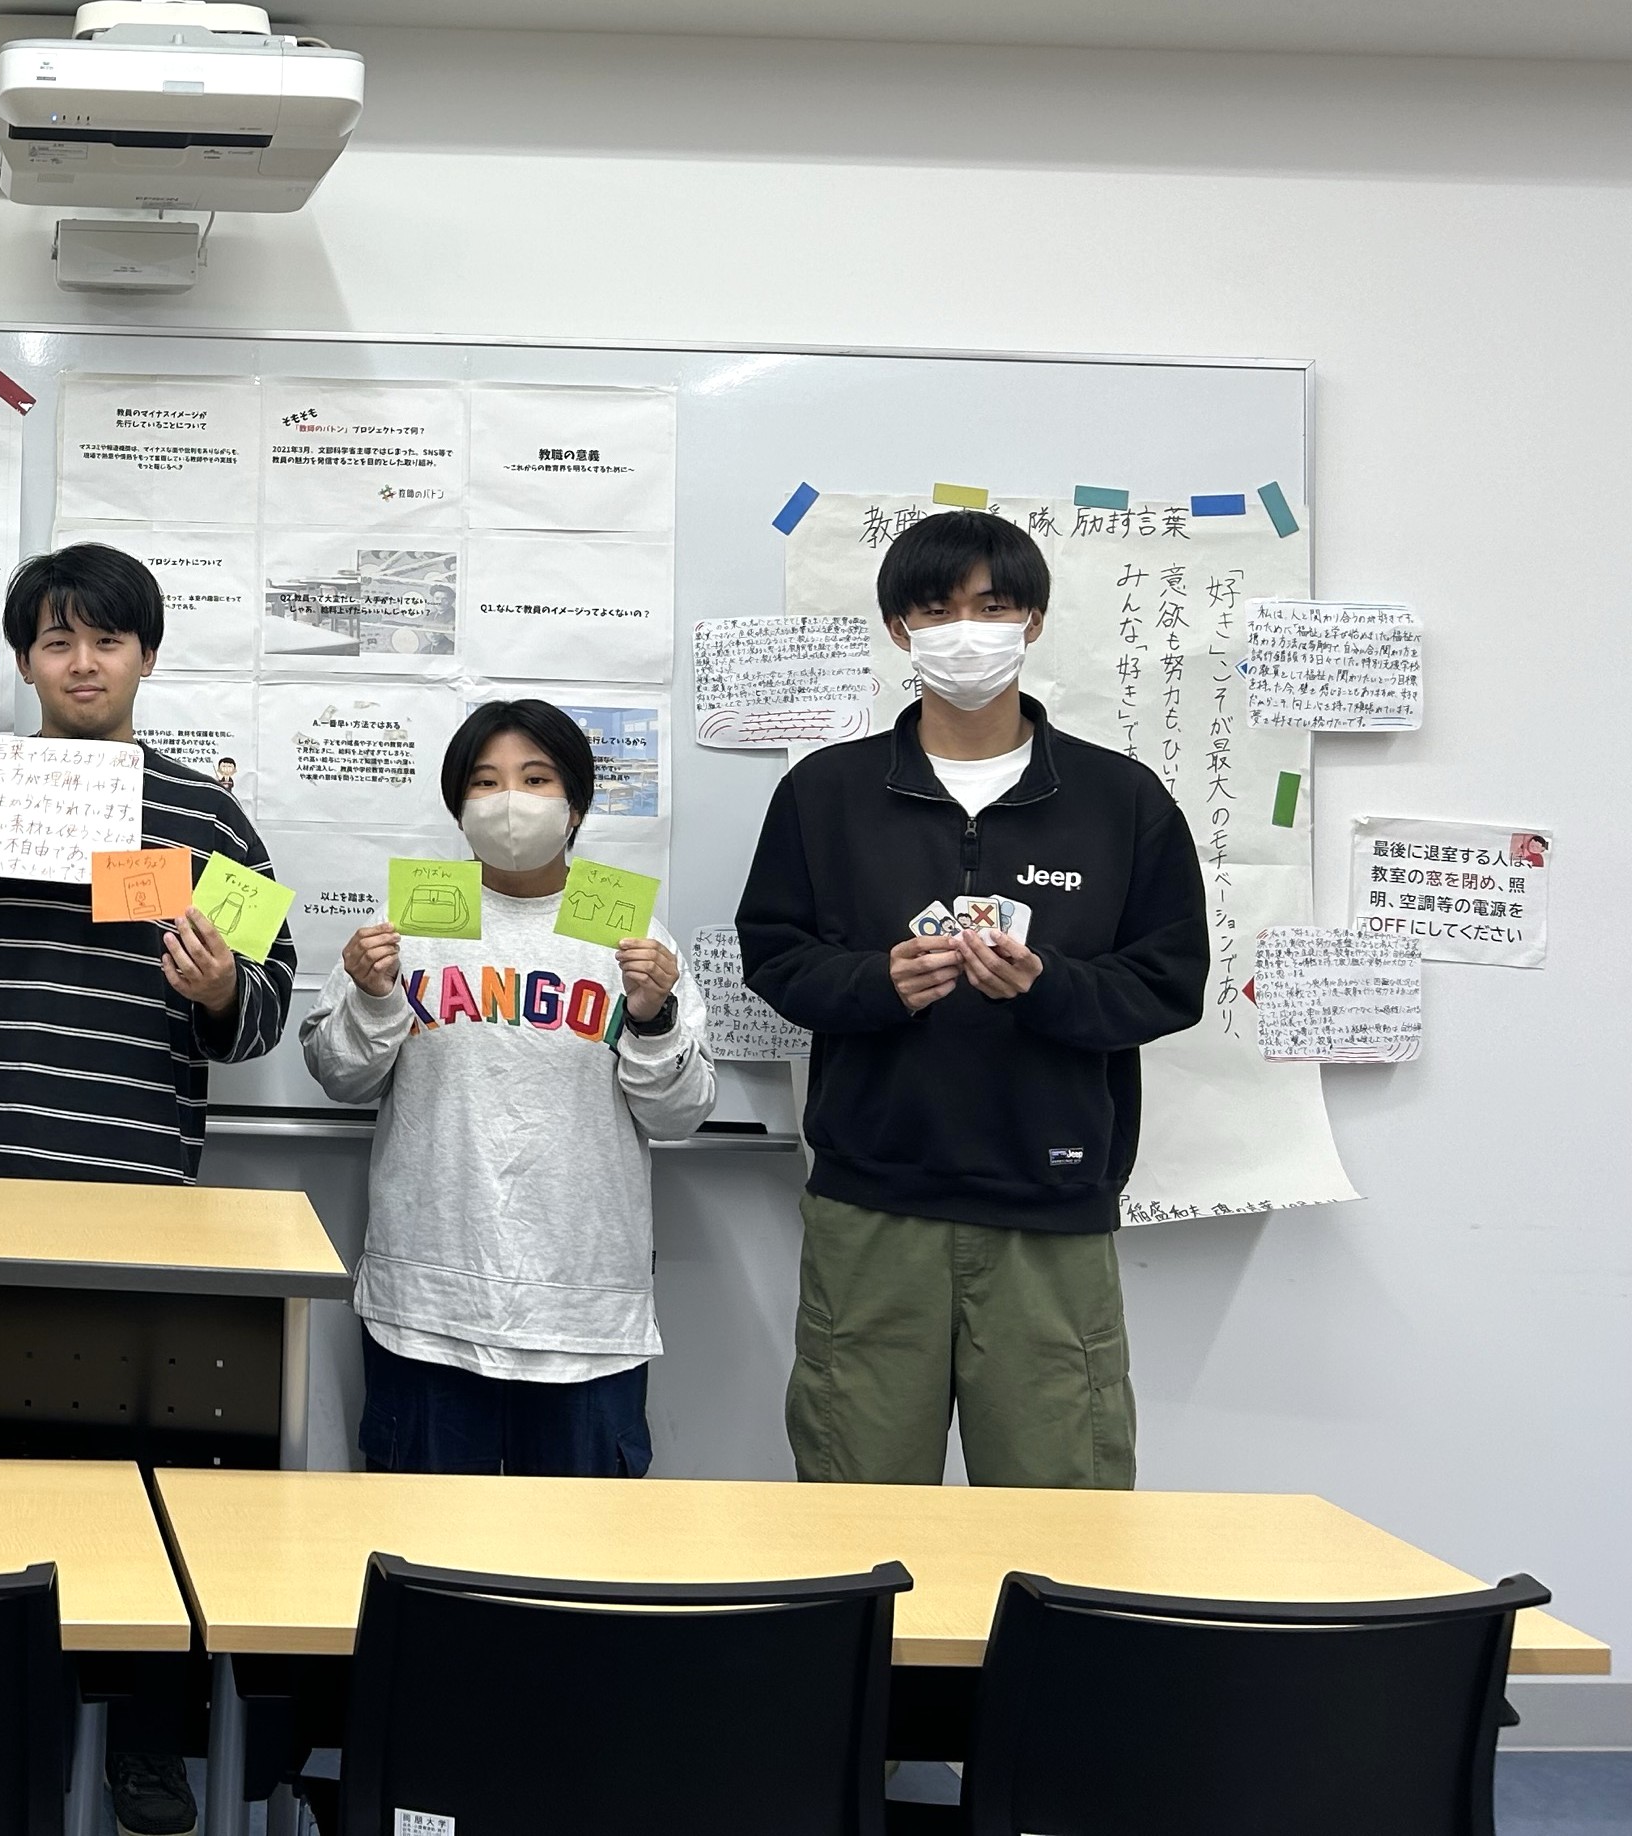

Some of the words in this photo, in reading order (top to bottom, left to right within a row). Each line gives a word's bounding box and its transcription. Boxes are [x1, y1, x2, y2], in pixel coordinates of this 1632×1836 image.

[116, 408, 208, 420] 教員のマイナスイメージが
[282, 408, 318, 427] そもそも
[115, 419, 207, 431] 先行していることについて
[538, 447, 601, 462] 教職の意義
[398, 487, 445, 500] 教師のバトン
[1155, 562, 1190, 805] 意欲も努力も、ひいて
[106, 855, 167, 870] れんらくちょう
[1372, 839, 1535, 869] 最後に退室する人は、
[225, 872, 259, 898] すいとう
[587, 869, 624, 889] きがえ
[1016, 864, 1082, 892] Jeep
[1371, 865, 1526, 894] 教室の窓を閉め、照
[1370, 890, 1524, 919] 明、空調等の電源を
